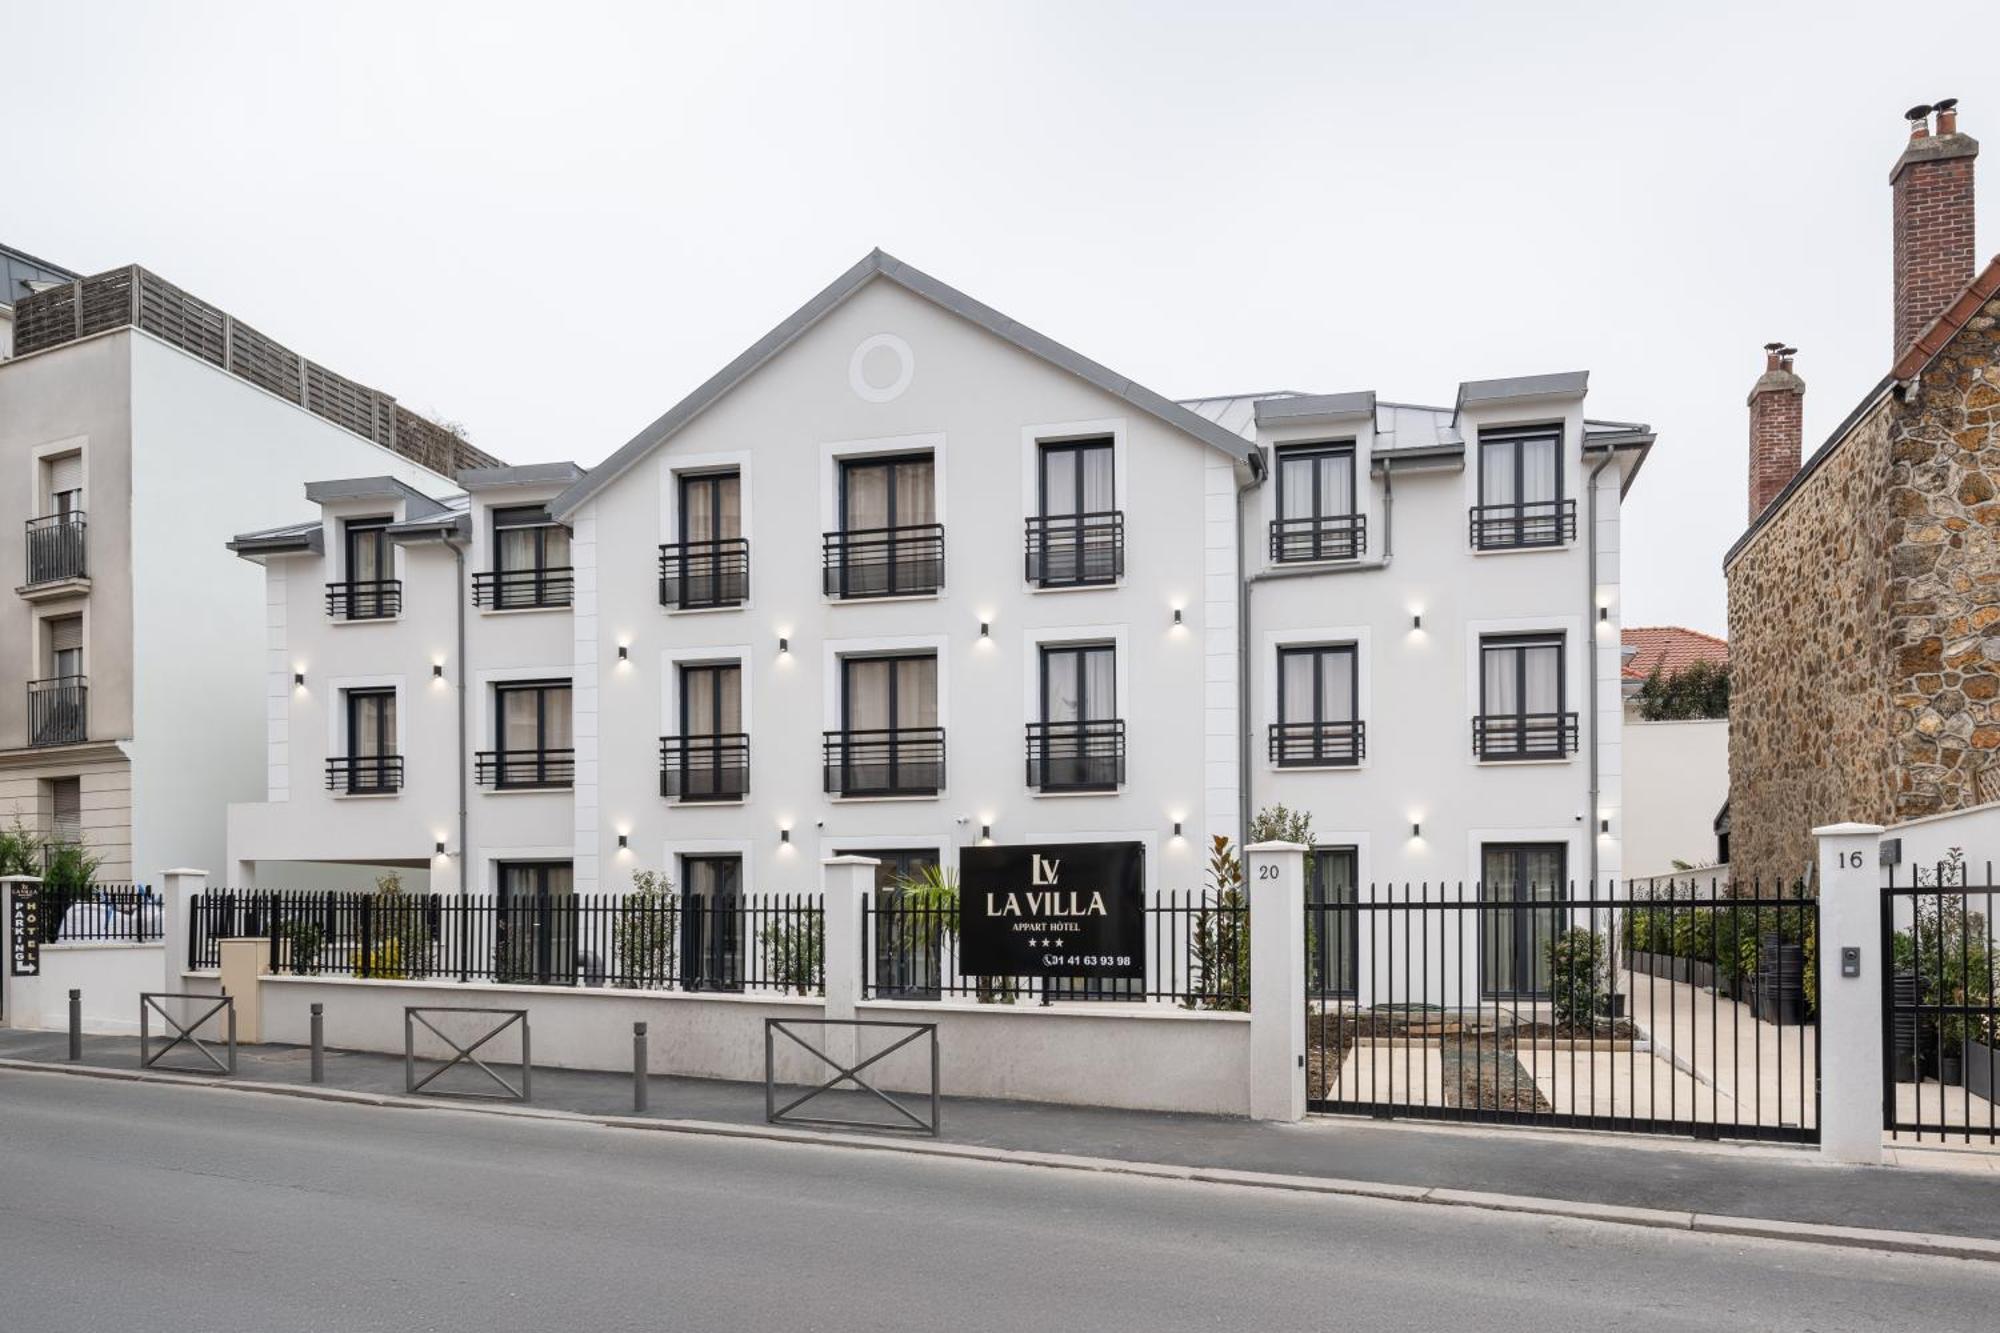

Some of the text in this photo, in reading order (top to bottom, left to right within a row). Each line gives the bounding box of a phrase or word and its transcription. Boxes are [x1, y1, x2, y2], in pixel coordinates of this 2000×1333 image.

[1838, 851, 1863, 869] 16
[1259, 865, 1279, 880] 20
[987, 891, 1108, 916] LA VILLA
[15, 902, 24, 960] PARKING
[27, 902, 36, 960] HOTEL
[1012, 922, 1047, 931] APPART
[1067, 955, 1080, 965] 41
[1083, 955, 1097, 965] 63
[1100, 956, 1114, 965] 93
[1116, 956, 1131, 966] 98
